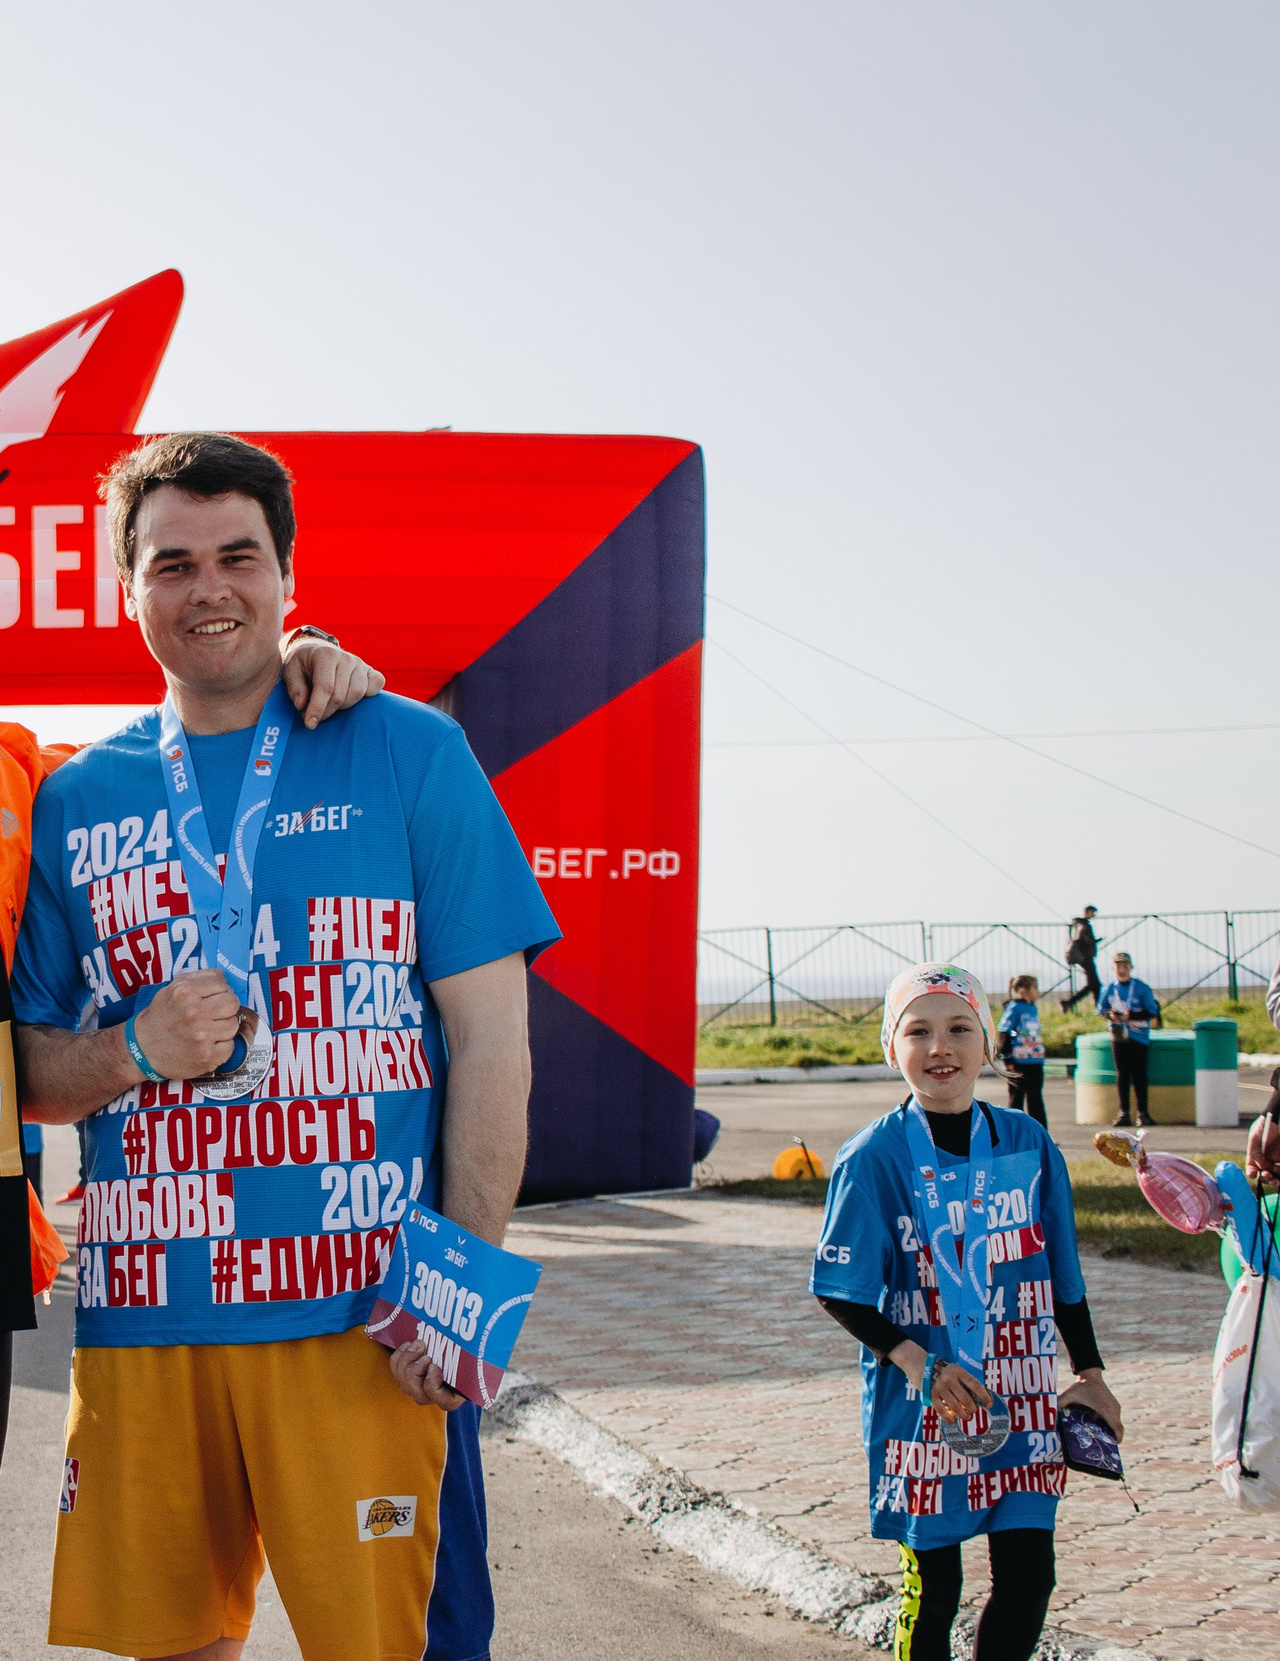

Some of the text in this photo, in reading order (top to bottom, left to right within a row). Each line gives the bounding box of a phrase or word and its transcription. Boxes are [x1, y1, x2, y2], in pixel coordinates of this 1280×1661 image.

[260, 725, 280, 757] ПСБ
[171, 761, 189, 793] ПСБ
[67, 809, 173, 888] 2024
[308, 897, 417, 964] #ЦЕЛ
[123, 1097, 377, 1177] #ГОРДОСТЬ
[941, 1171, 957, 1182] СБ
[974, 1170, 986, 1197] ПСБ
[925, 1181, 940, 1209] ПСБ
[418, 1217, 439, 1234] ПСБ
[411, 1261, 483, 1342] 30013
[876, 1475, 943, 1517] #ЗАБЕГ
[362, 1507, 414, 1530] LAKERS
